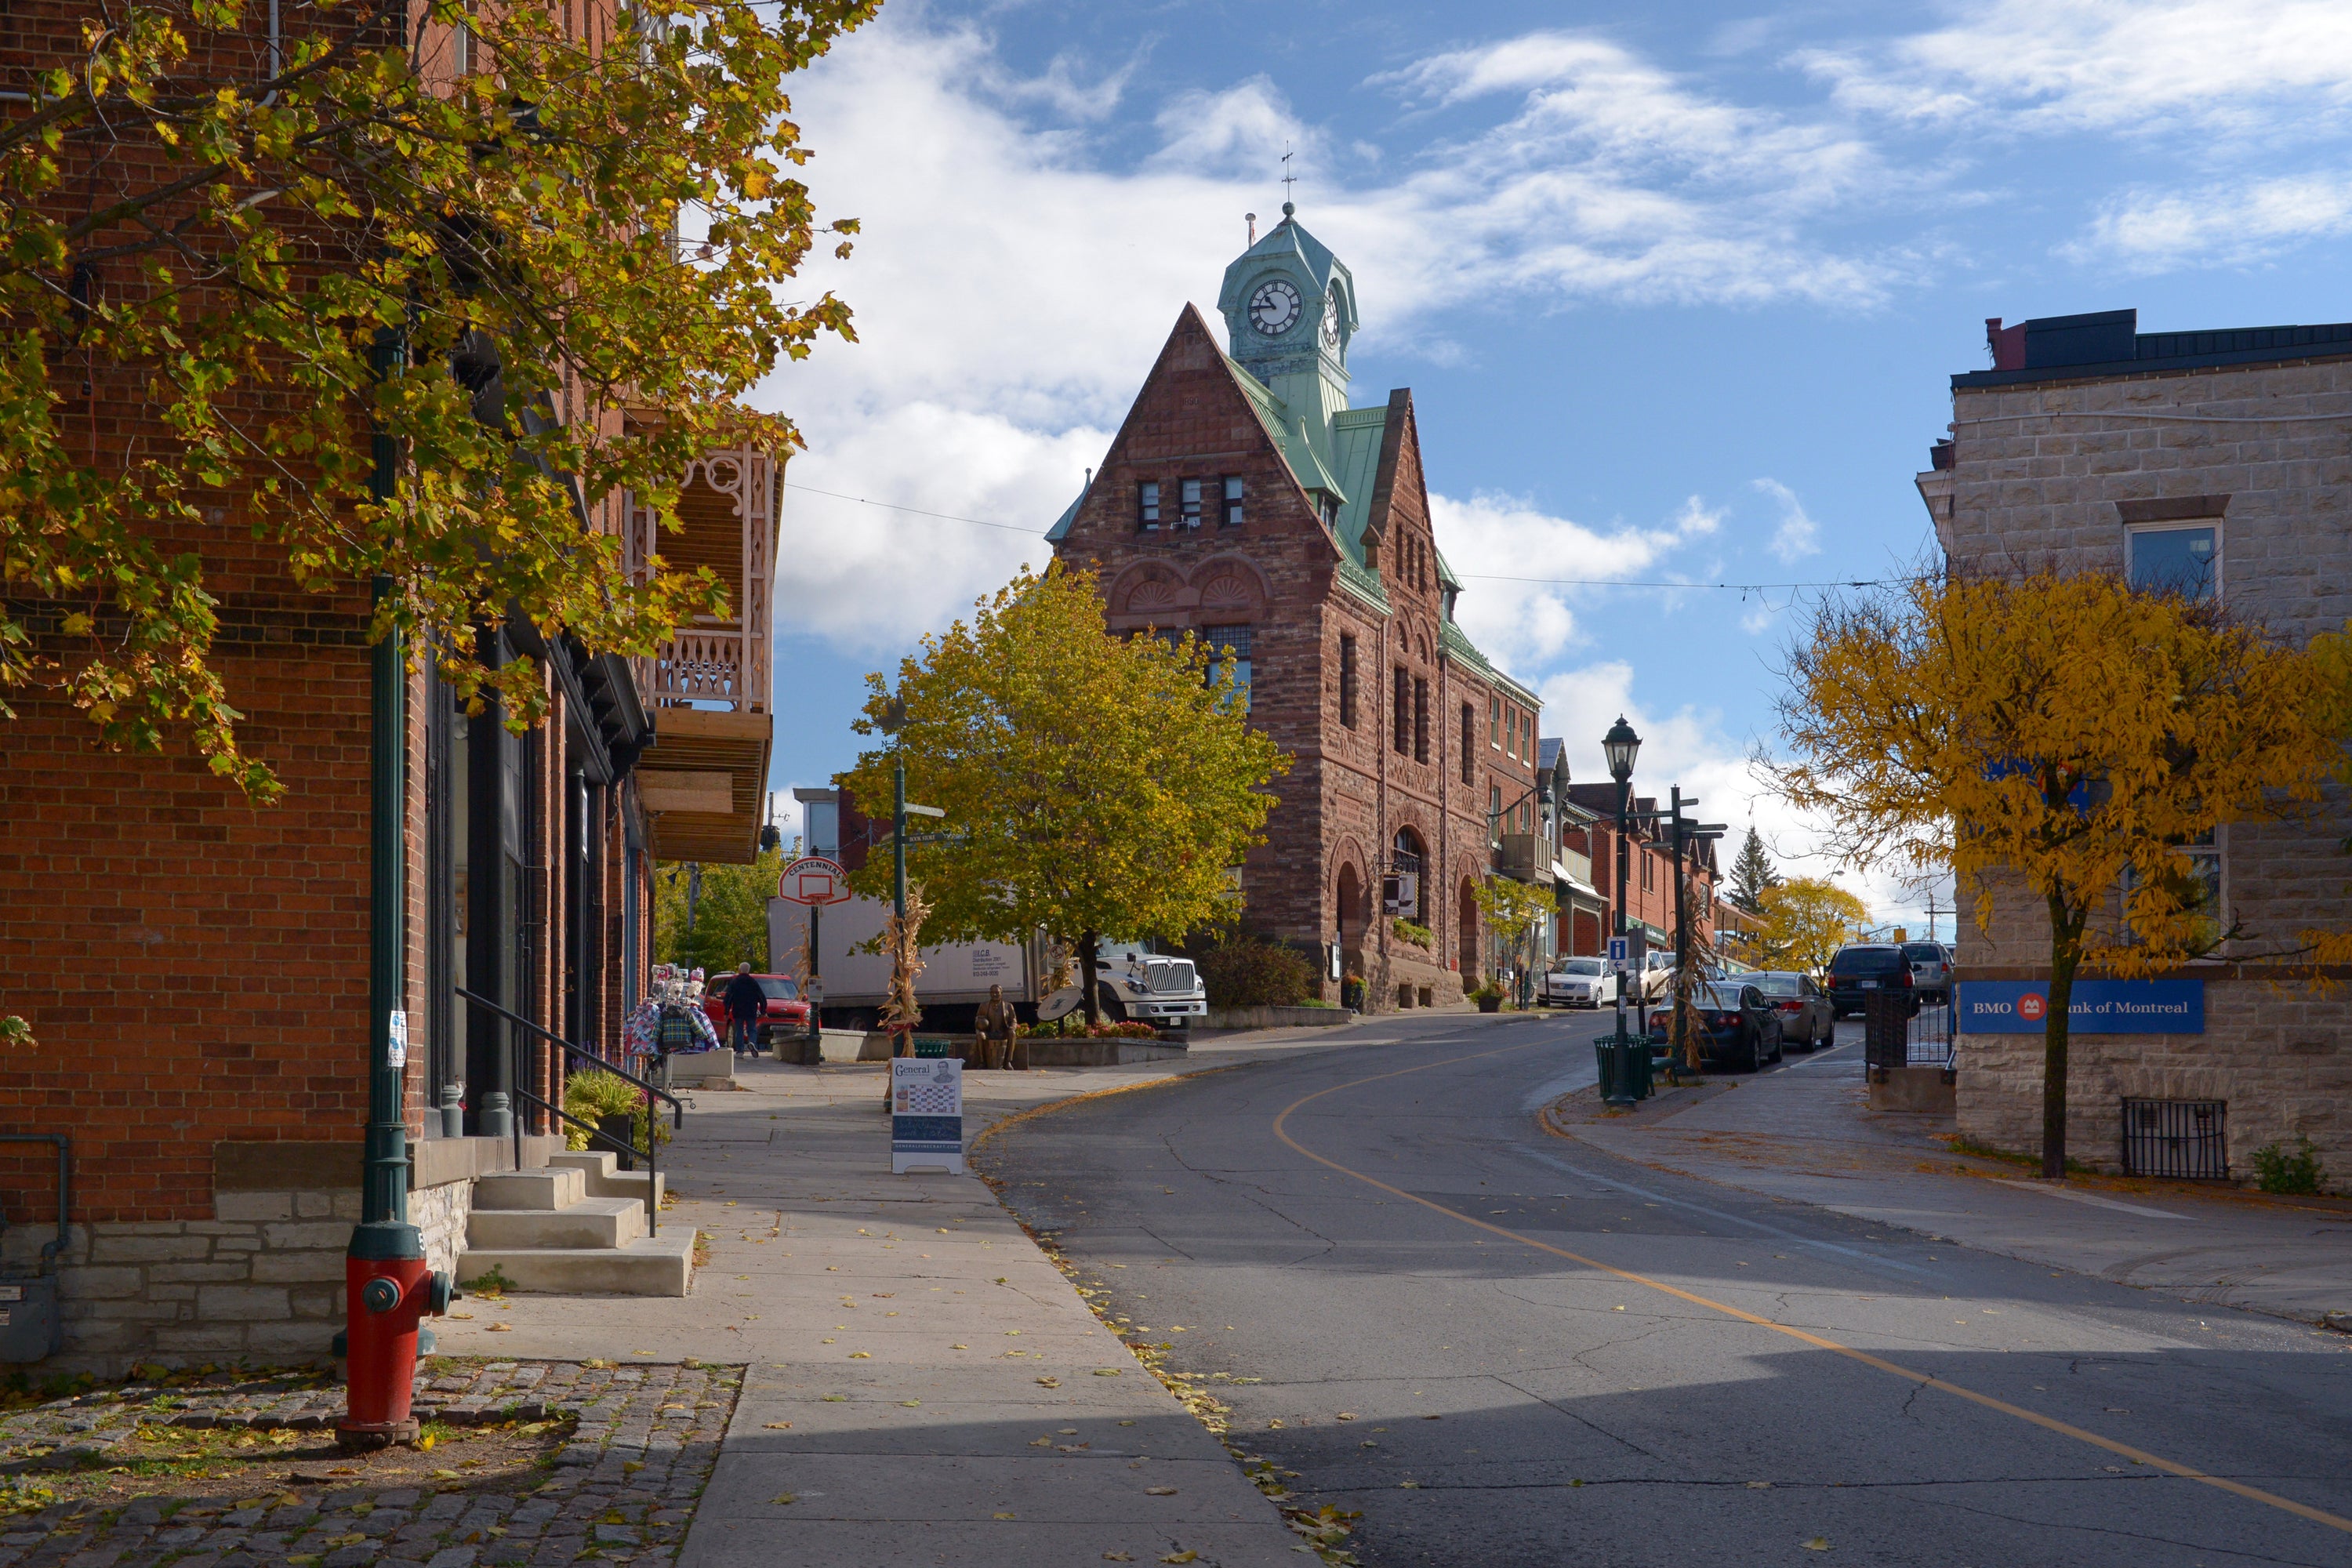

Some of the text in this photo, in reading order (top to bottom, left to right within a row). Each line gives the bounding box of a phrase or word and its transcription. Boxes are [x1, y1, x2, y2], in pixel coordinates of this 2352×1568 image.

[789, 862, 842, 878] CENTENNIAL
[1973, 1001, 2188, 1014] BMO nk of Montreal
[895, 1065, 930, 1076] General
